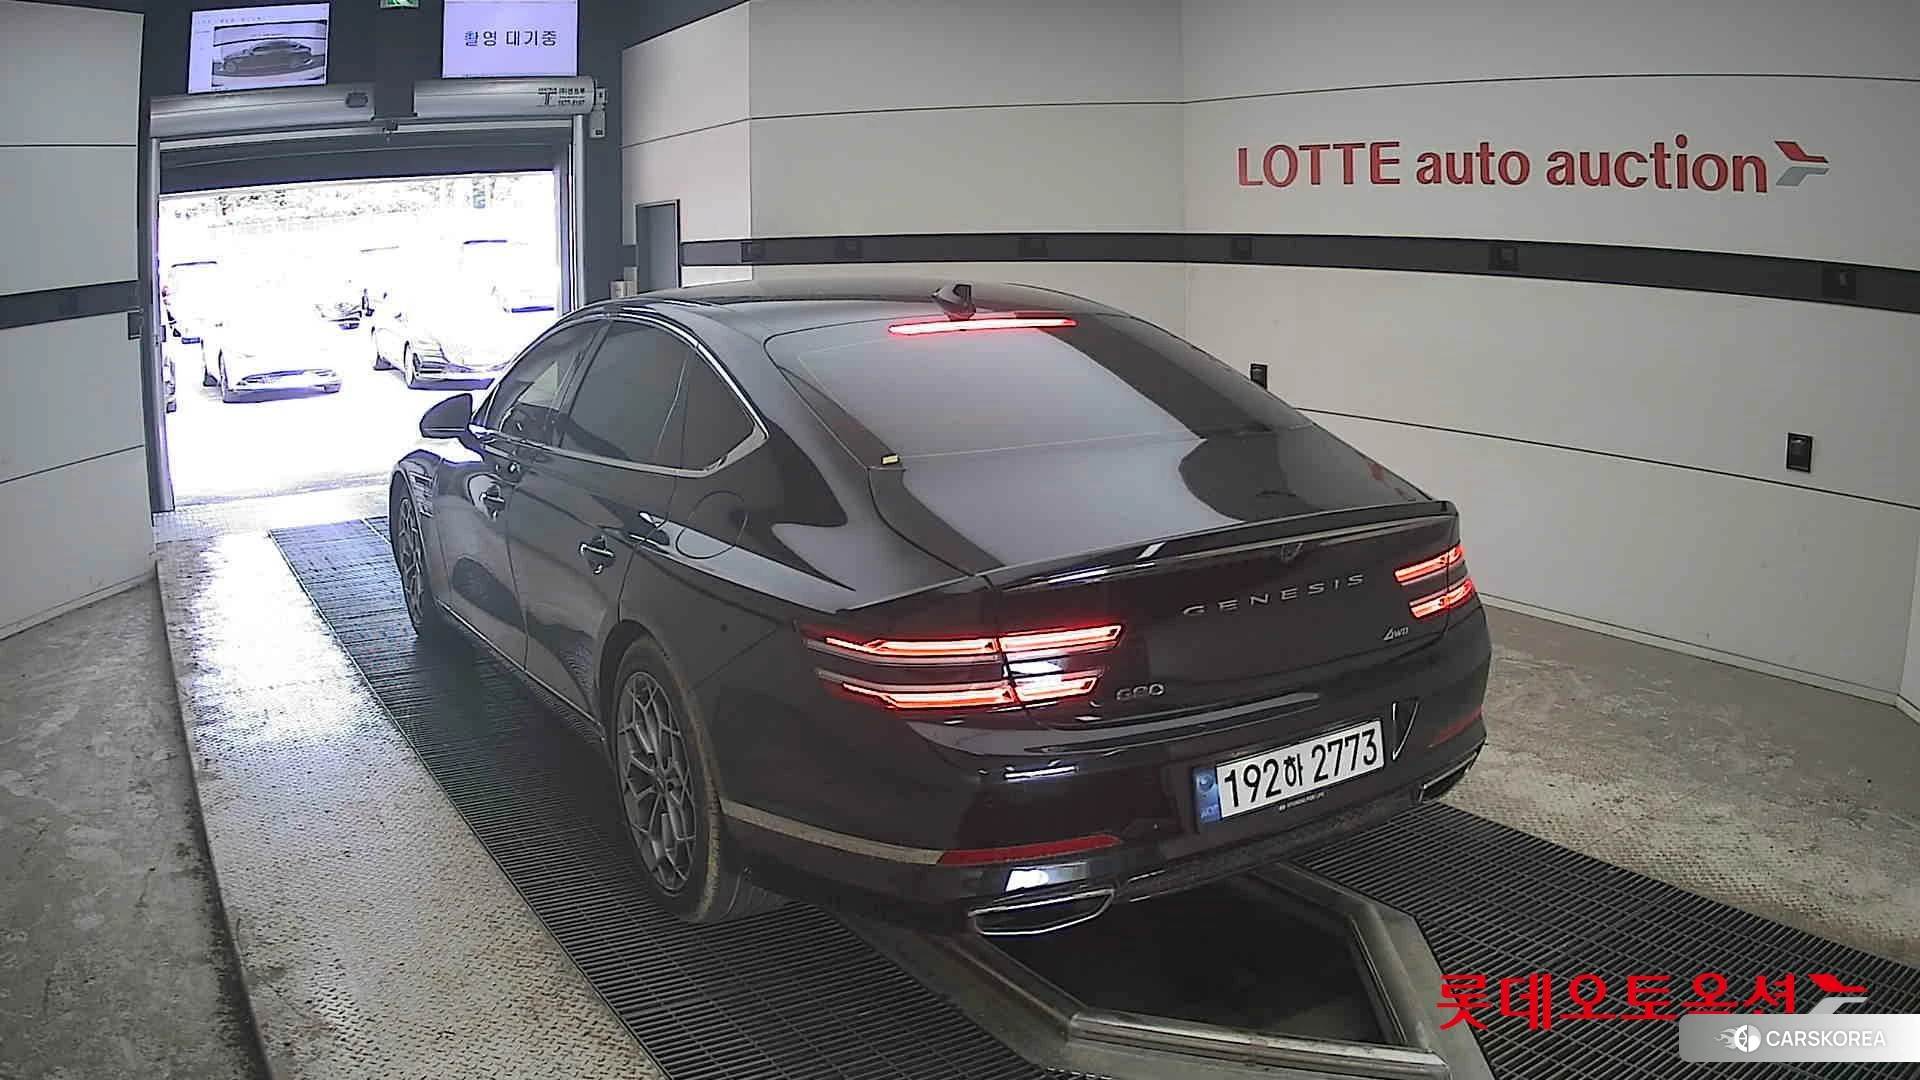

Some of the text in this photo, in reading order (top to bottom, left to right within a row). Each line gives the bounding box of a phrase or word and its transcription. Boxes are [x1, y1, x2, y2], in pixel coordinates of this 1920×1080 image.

[505, 30, 557, 47] 대기중
[1238, 134, 1768, 193] LOTTE auto auction
[1182, 573, 1364, 616] GENESIS
[1223, 728, 1378, 808] 192하 2773
